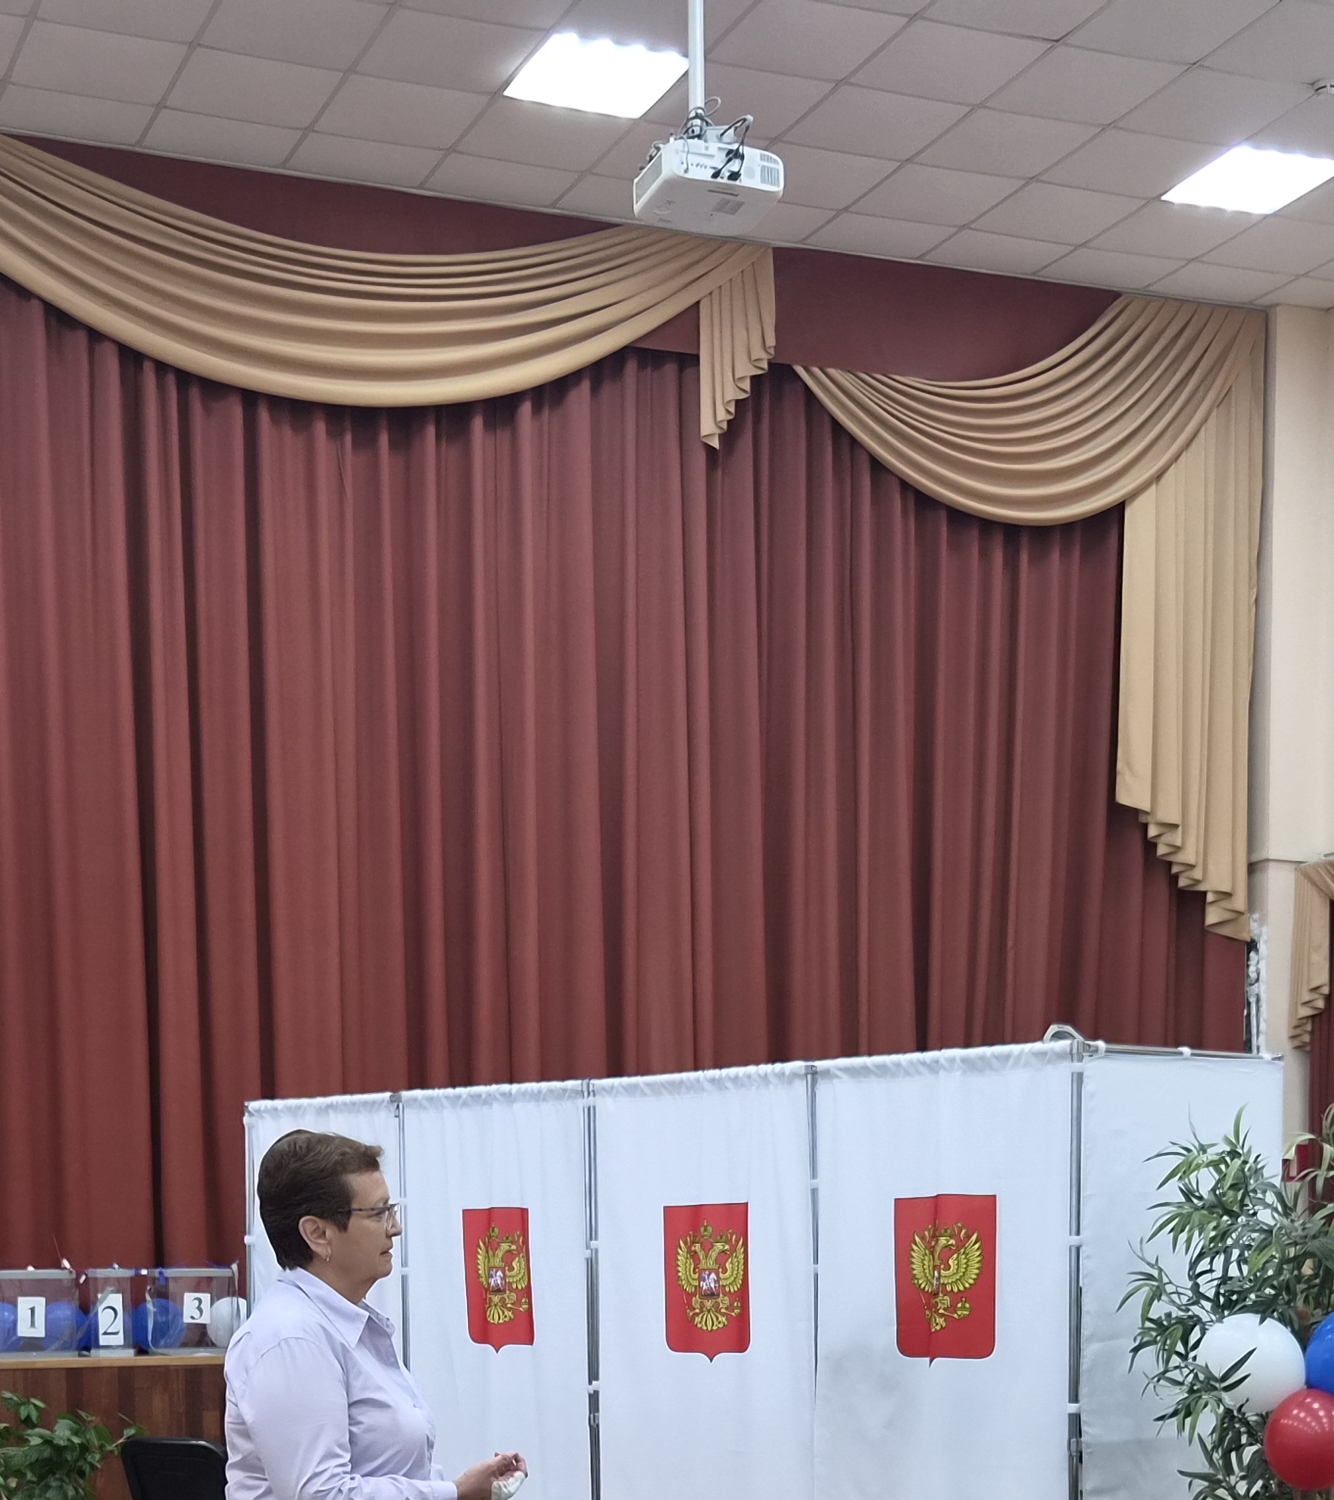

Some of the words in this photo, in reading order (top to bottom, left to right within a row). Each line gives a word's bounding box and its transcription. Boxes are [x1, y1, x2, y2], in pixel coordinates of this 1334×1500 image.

[27, 1305, 37, 1330] 1
[101, 1305, 120, 1336] 2
[189, 1296, 204, 1321] 3
